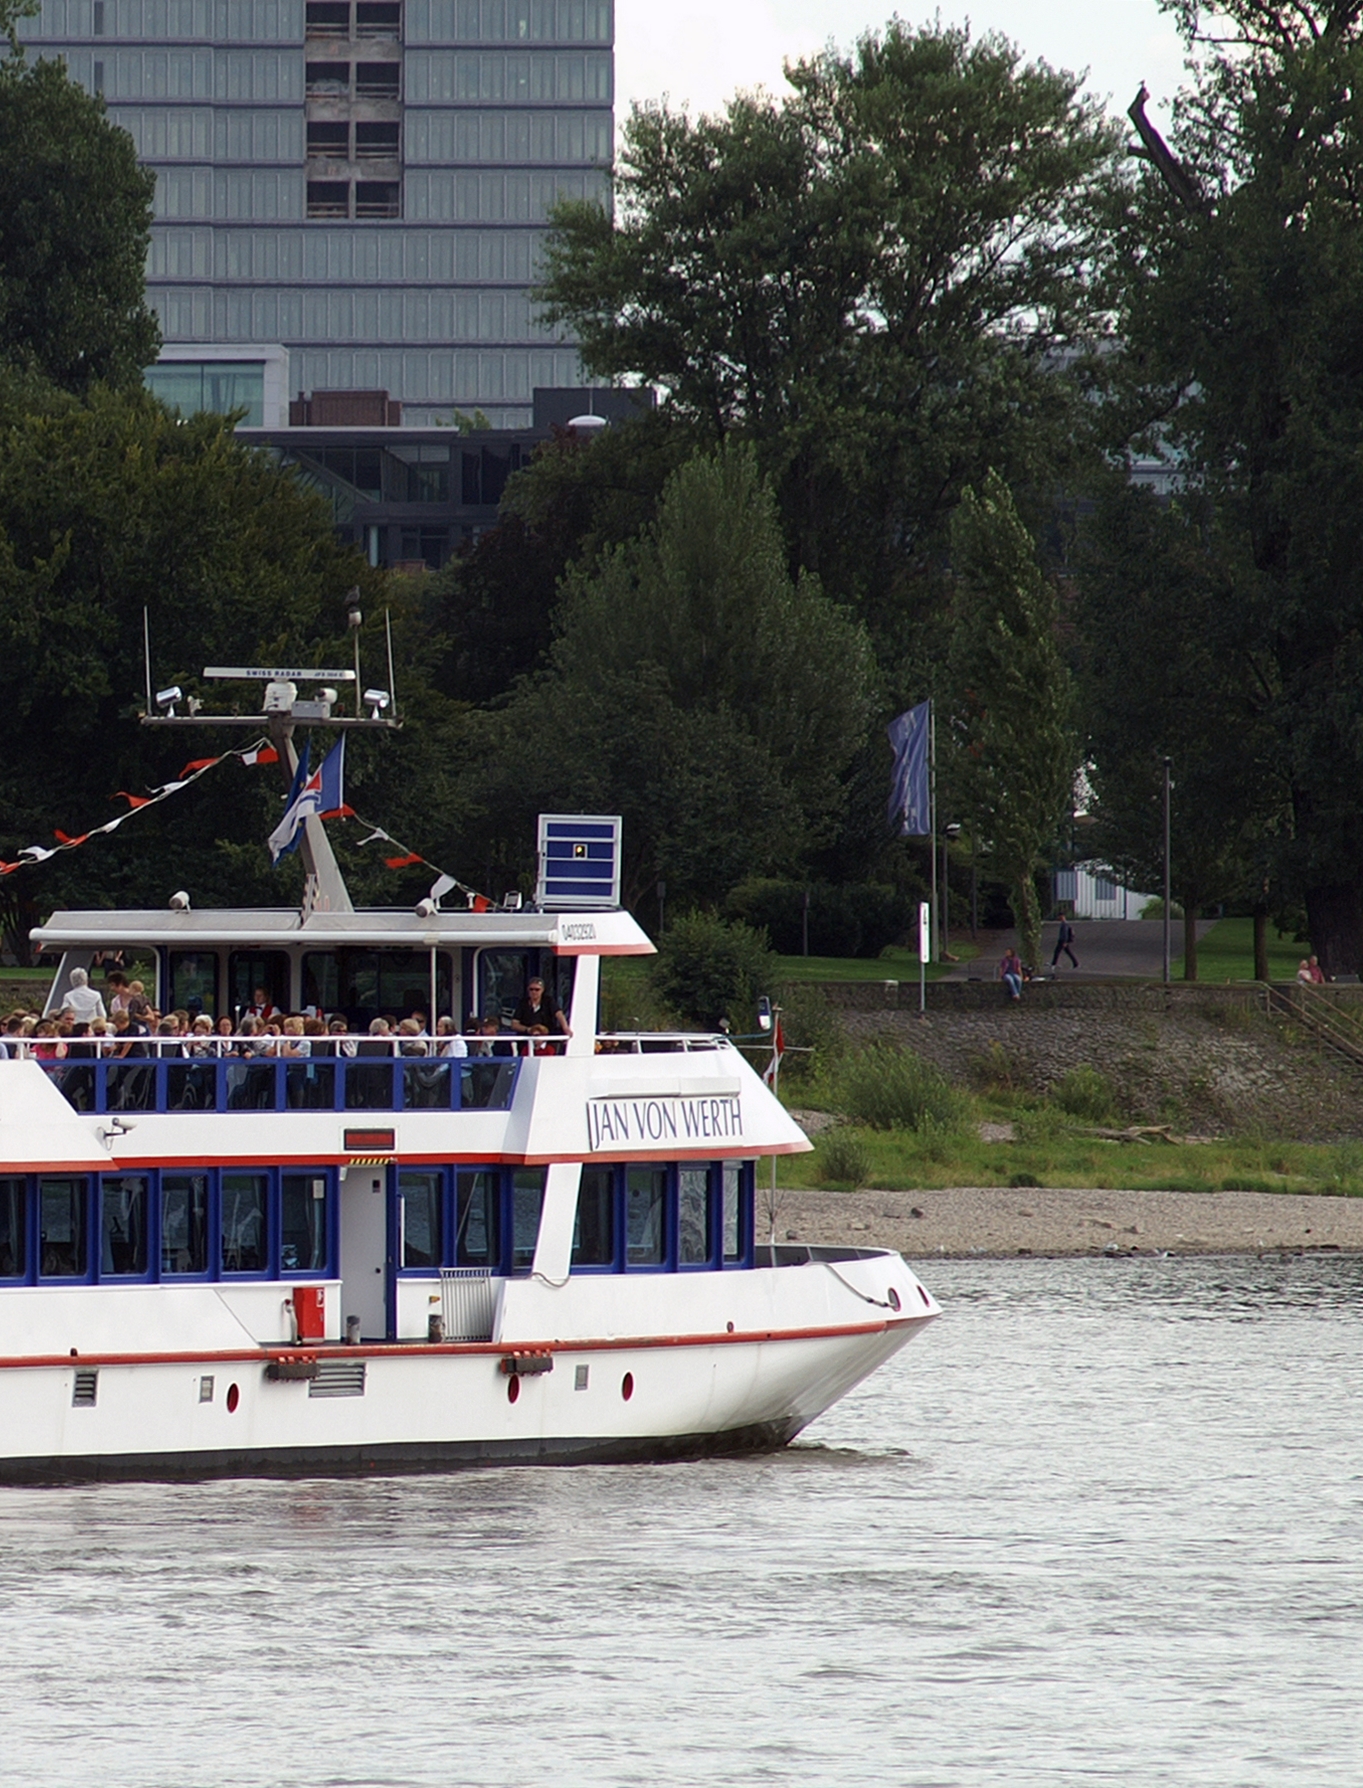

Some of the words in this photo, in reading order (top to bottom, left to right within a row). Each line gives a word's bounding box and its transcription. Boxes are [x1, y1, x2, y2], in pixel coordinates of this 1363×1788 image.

[593, 1102, 629, 1149] JAN
[633, 1101, 678, 1140] VON
[681, 1098, 743, 1138] WERTH
